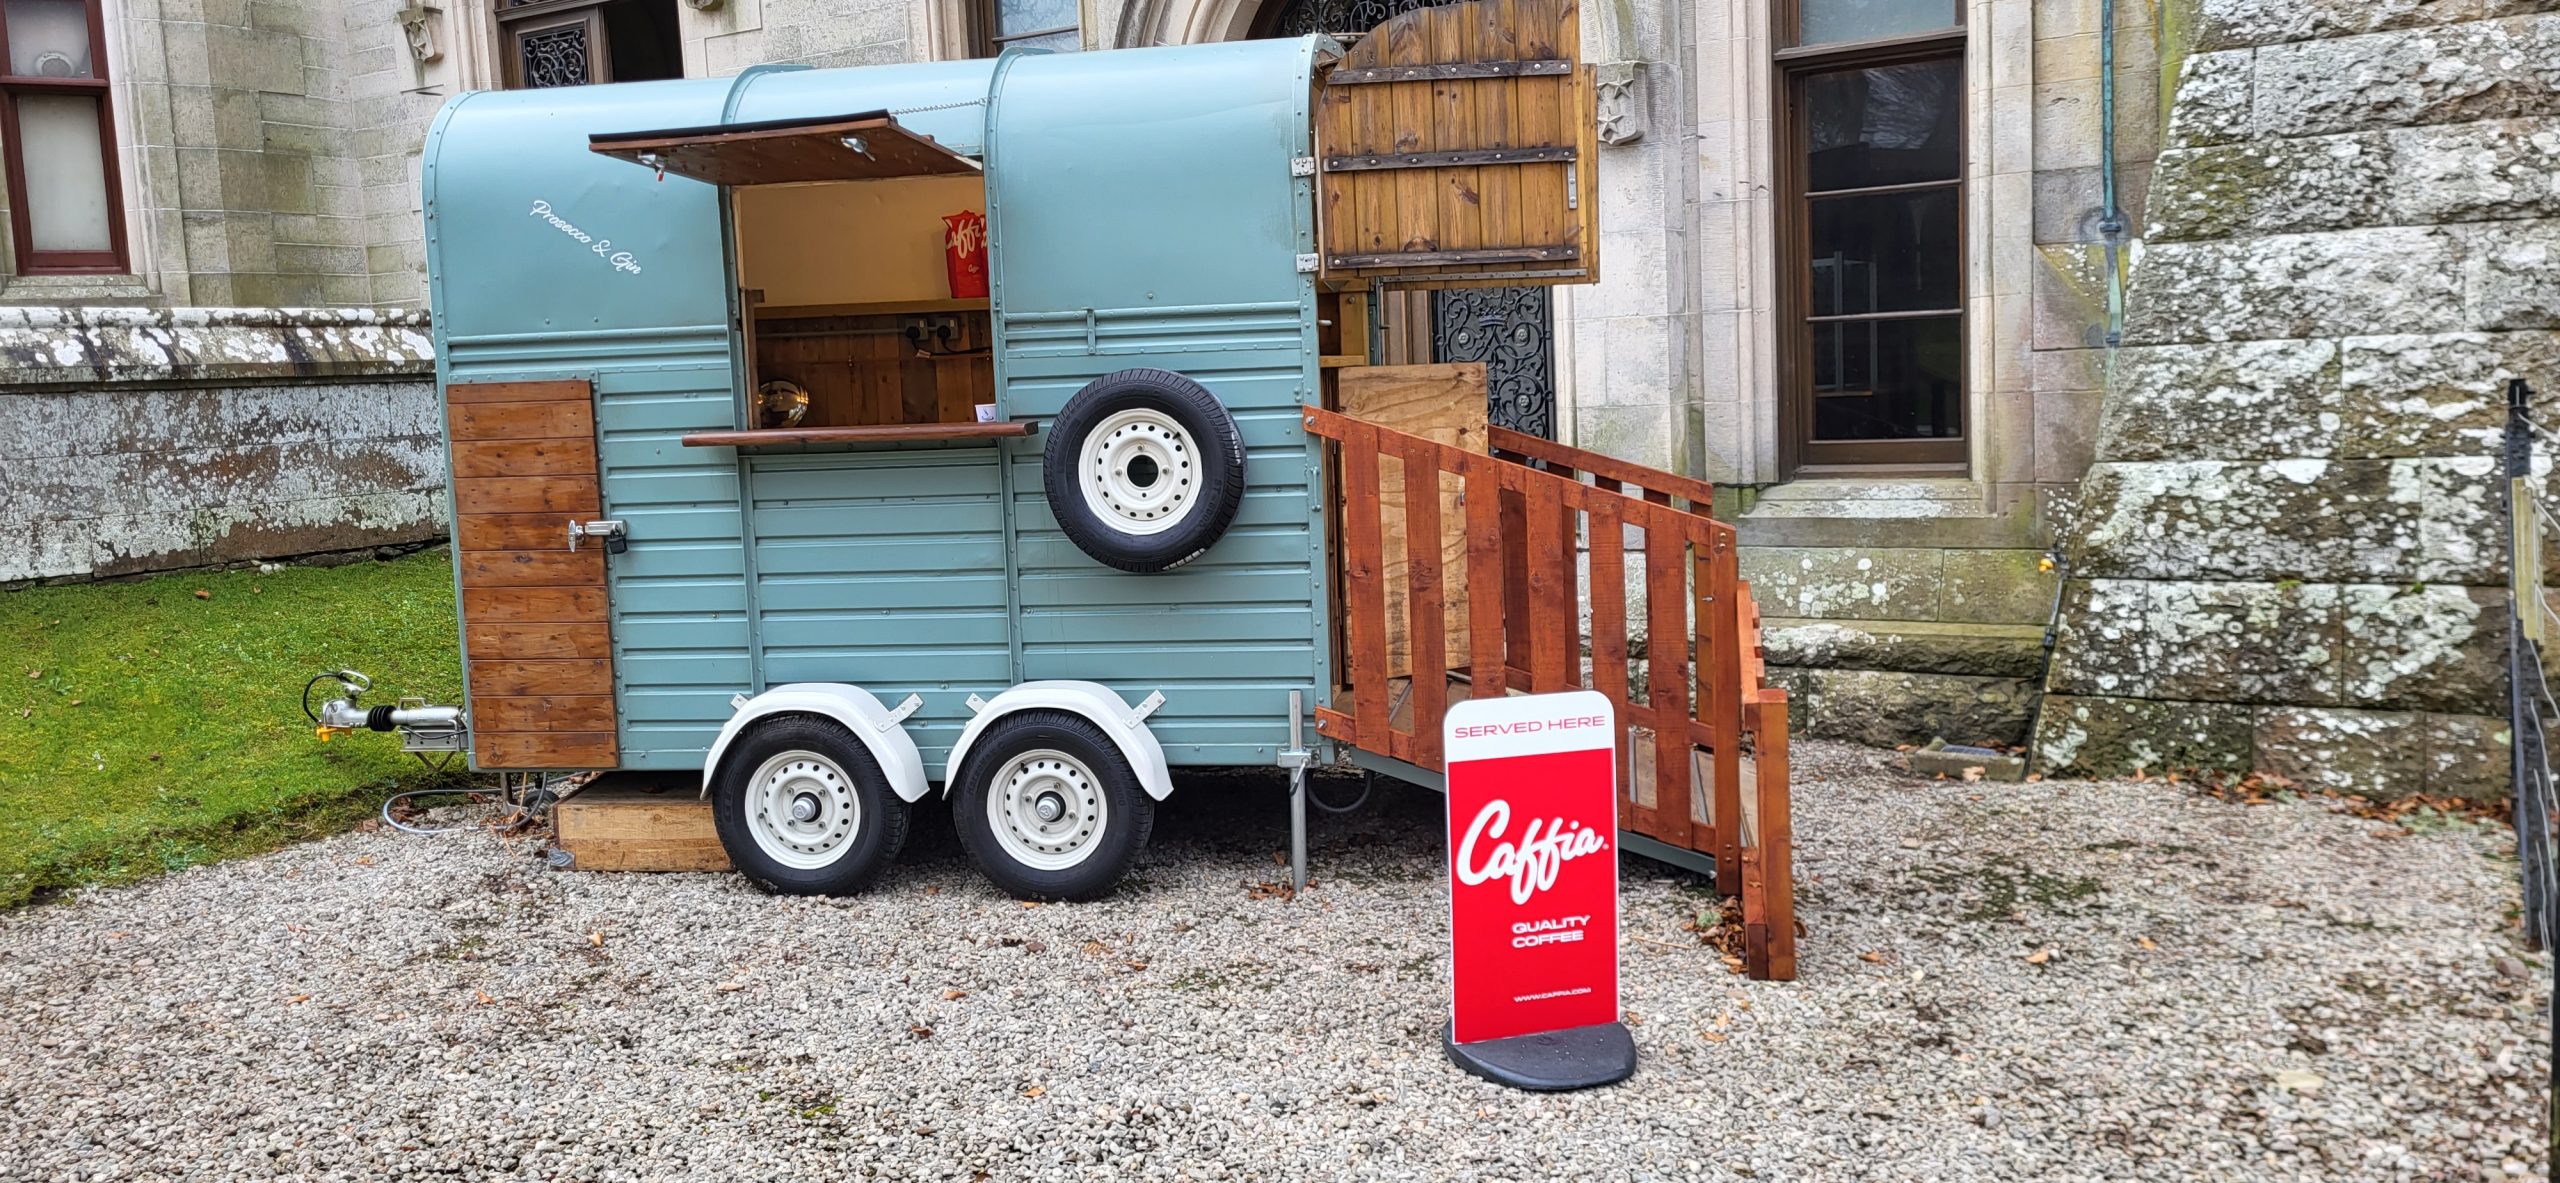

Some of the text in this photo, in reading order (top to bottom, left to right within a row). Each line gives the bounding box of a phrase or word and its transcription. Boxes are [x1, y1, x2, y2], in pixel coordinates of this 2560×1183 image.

[529, 199, 642, 275] Prosecco & Gin
[1454, 715, 1606, 739] SERVED HERE
[1456, 799, 1605, 905] Caffia
[1512, 915, 1591, 934] QUALITY
[1512, 930, 1585, 948] COFFEE
